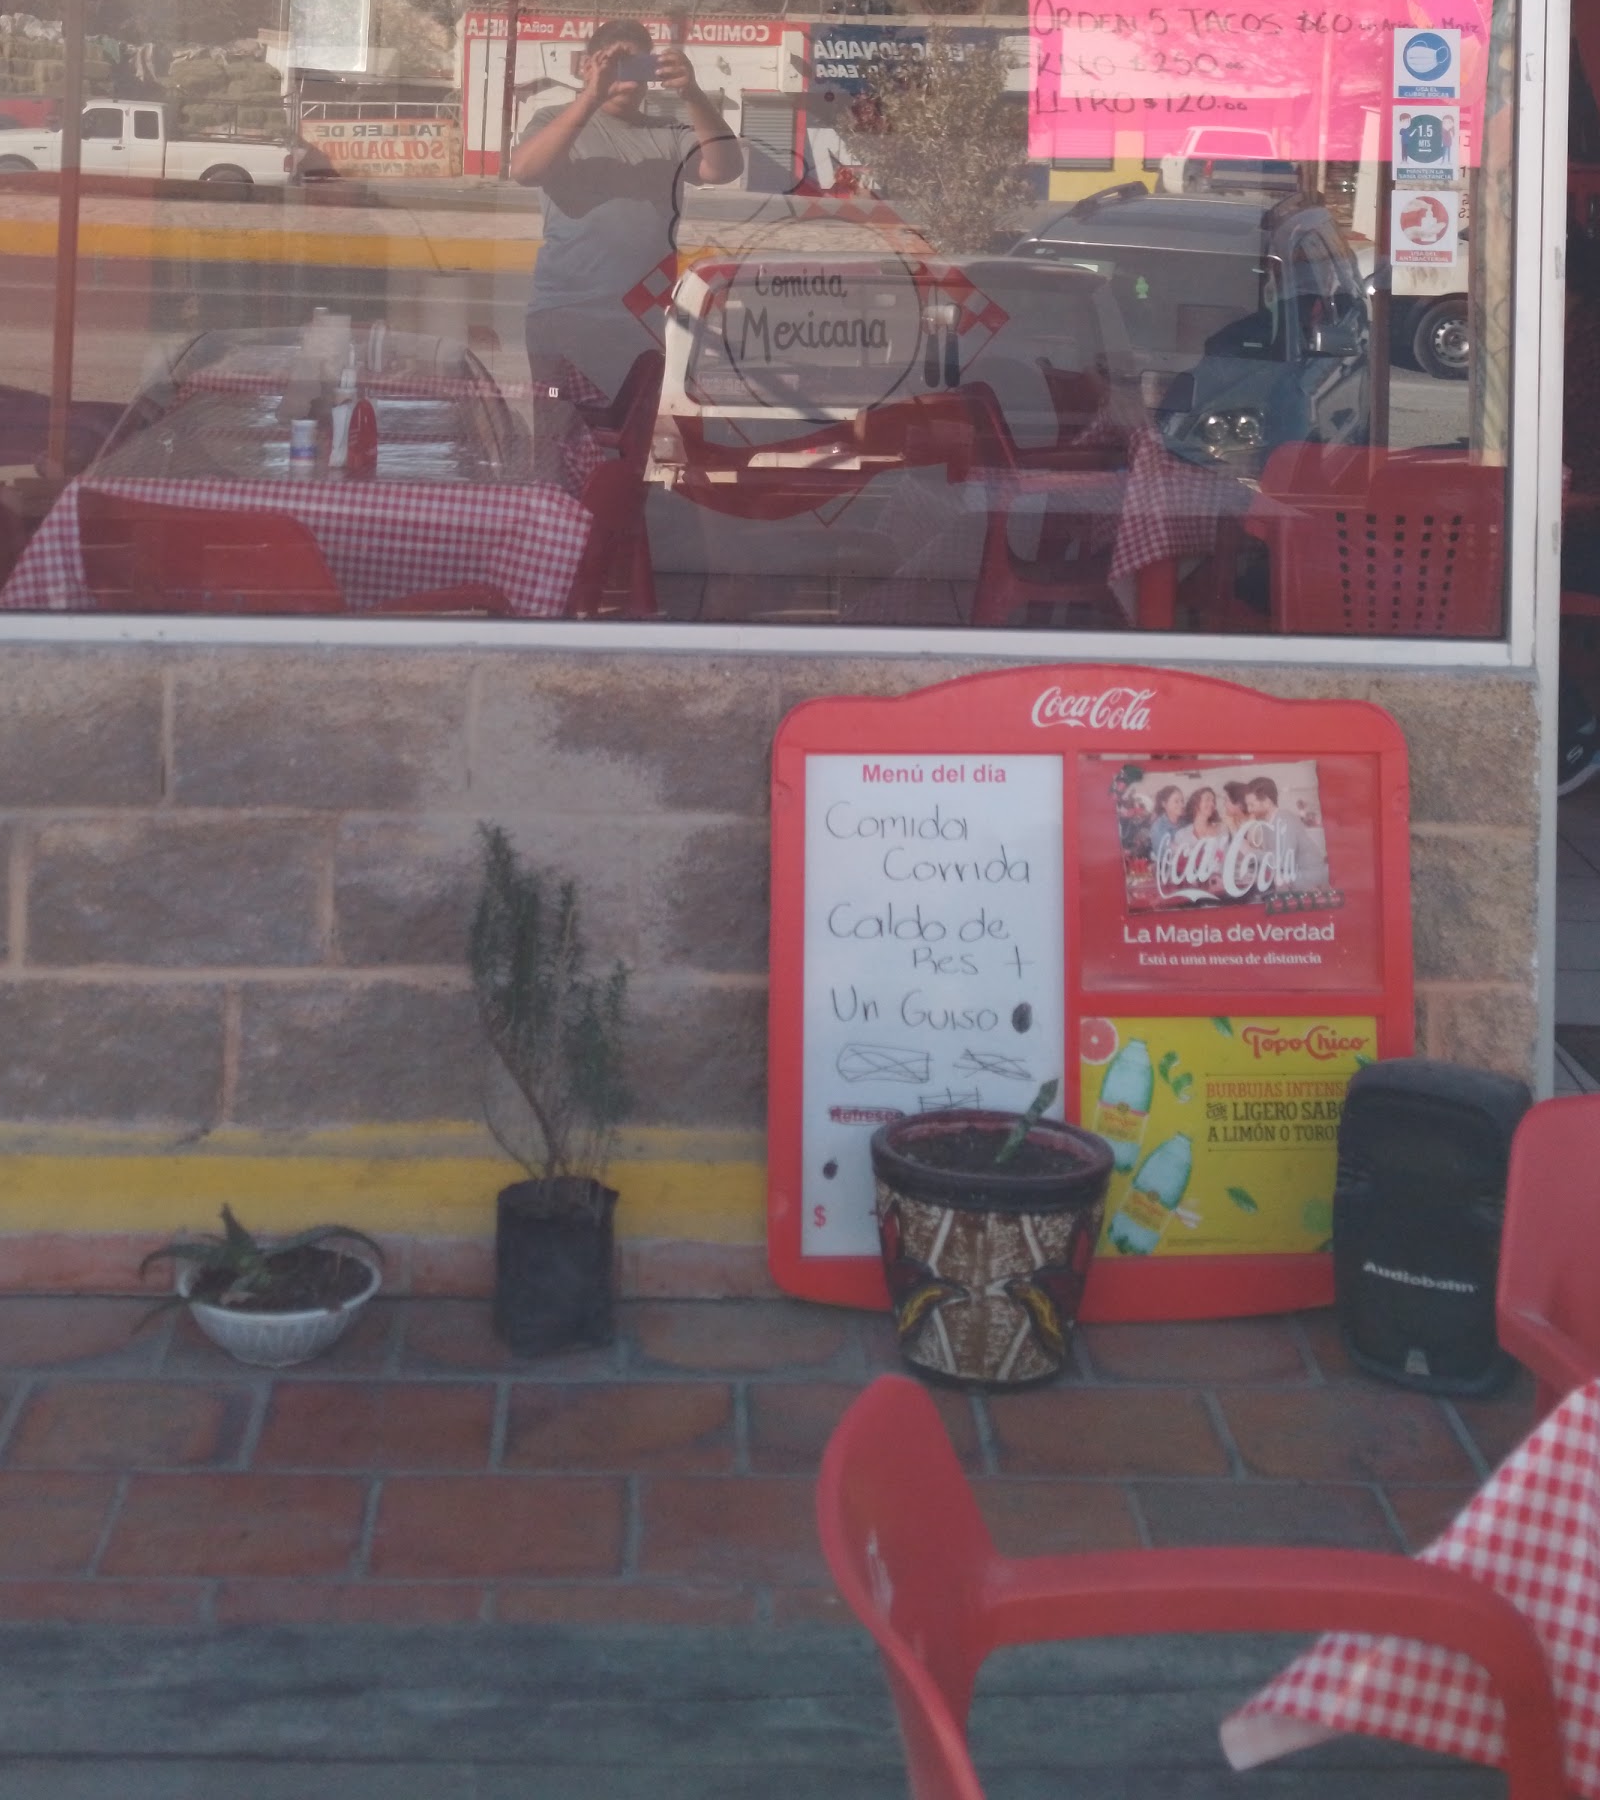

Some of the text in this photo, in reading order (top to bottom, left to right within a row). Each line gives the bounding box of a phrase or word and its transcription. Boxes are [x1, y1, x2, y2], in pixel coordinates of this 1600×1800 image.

[1149, 8, 1166, 35] 5
[1177, 6, 1282, 36] TACOS
[754, 264, 848, 300] Comida
[739, 307, 890, 365] Mexicana
[1031, 685, 1158, 731] Coca-Cola
[861, 762, 926, 784] Menú
[931, 764, 966, 783] del
[825, 802, 969, 843] Comida
[884, 845, 1031, 884] Corrida
[826, 903, 1010, 943] Caldo de
[1123, 922, 1336, 948] La Magia de Verdad
[911, 946, 979, 978] Res
[1139, 952, 1165, 966] Está
[1180, 955, 1206, 965] una
[1209, 955, 1243, 965] mesa
[1245, 953, 1261, 965] de
[1264, 951, 1322, 965] distancia
[832, 986, 879, 1024] Un
[1206, 1080, 1348, 1098] BURBUJAS INTENS
[1233, 1102, 1298, 1121] LIGERO
[1207, 1124, 1219, 1142] A
[1223, 1122, 1276, 1142] LIMÓN
[1279, 1125, 1290, 1141] O
[814, 1205, 826, 1228] $
[1362, 1260, 1477, 1295] Audiobahn
